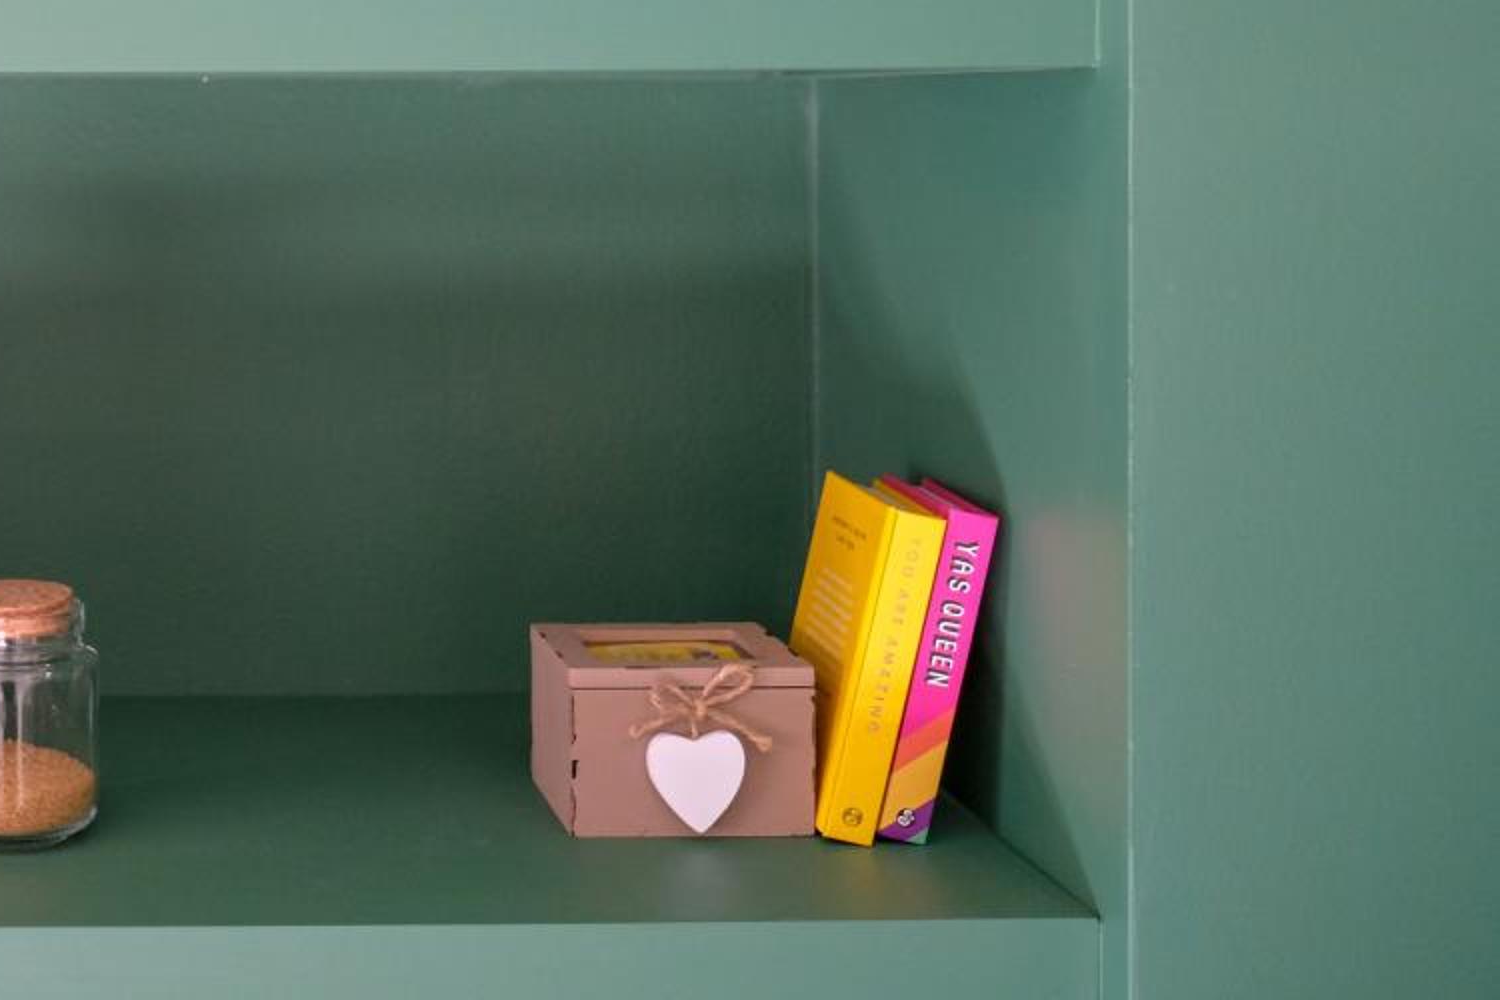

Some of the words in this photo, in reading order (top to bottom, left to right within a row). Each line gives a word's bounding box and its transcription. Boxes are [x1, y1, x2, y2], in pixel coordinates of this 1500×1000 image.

[902, 538, 922, 576] YOU
[949, 541, 980, 594] YAS
[926, 603, 966, 688] QUEEN
